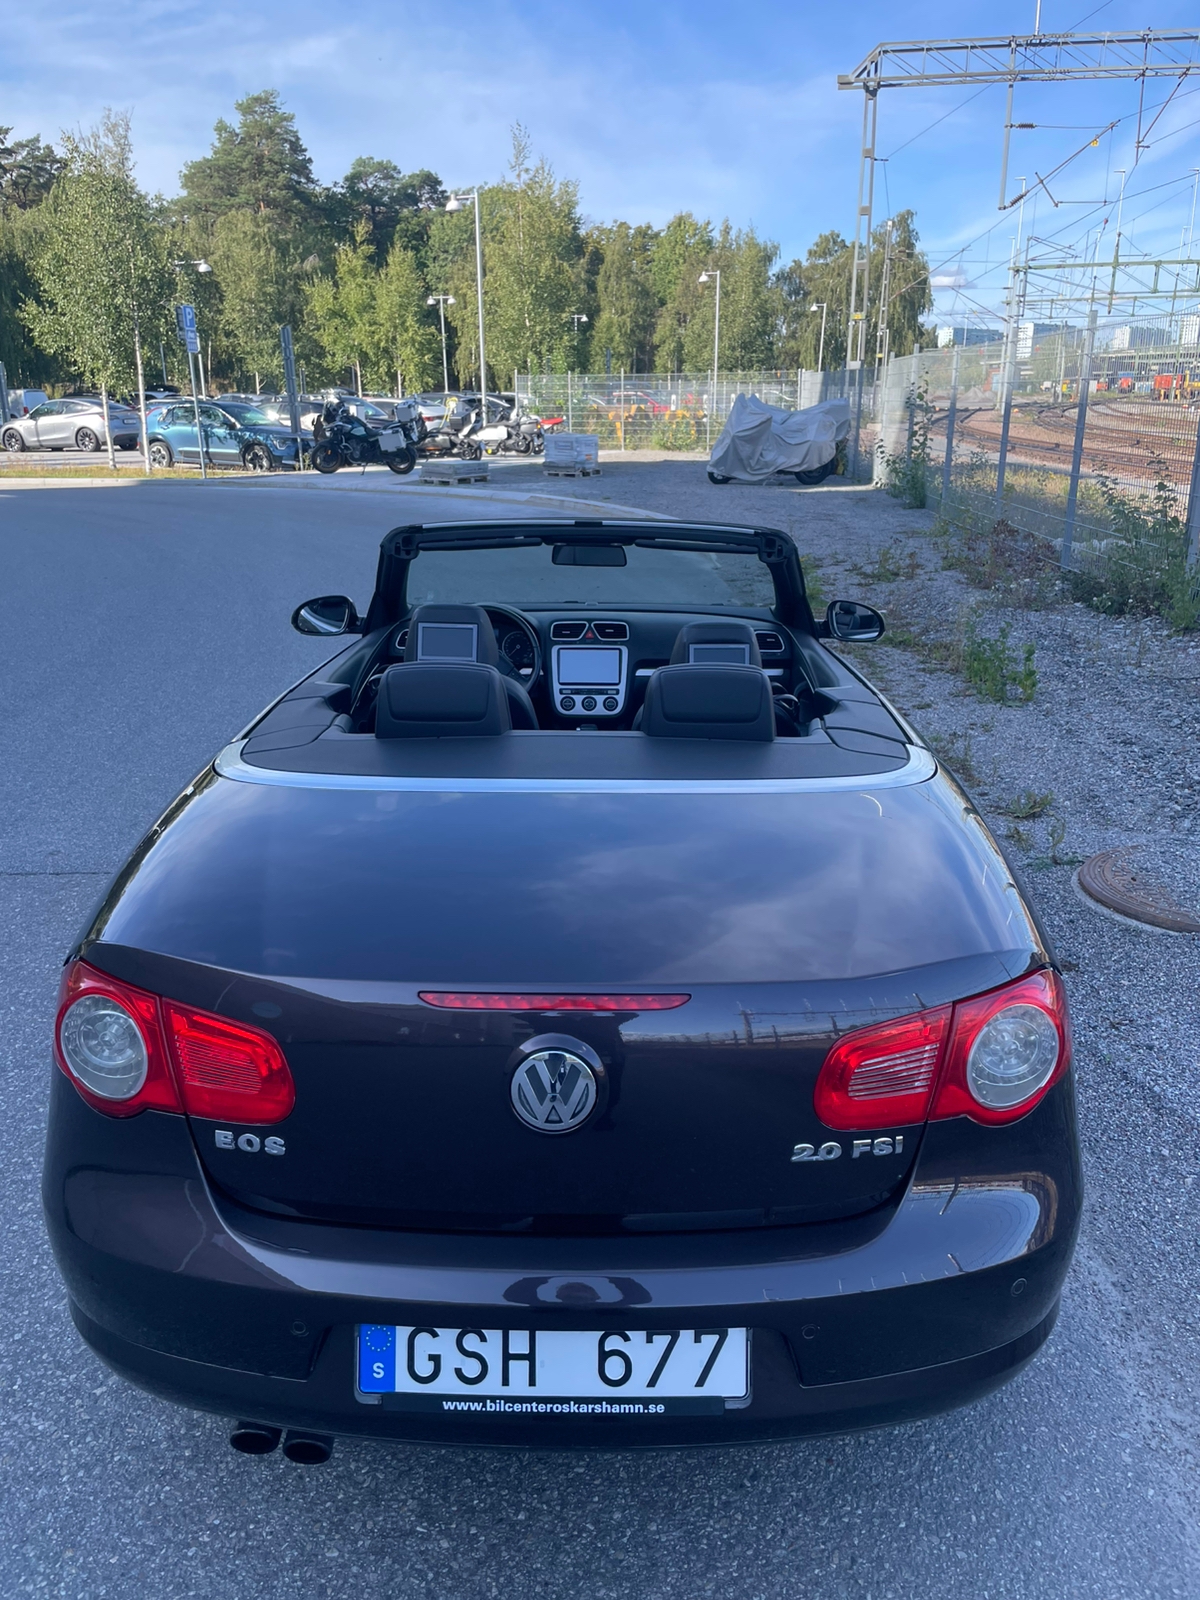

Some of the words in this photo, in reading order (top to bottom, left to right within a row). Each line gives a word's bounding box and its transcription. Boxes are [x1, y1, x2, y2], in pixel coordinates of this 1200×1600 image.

[185, 307, 193, 326] P
[511, 1051, 597, 1131] VW
[214, 1129, 286, 1156] EOS
[790, 1141, 842, 1162] 2.0
[852, 1135, 904, 1159] FSI
[372, 1362, 385, 1379] S
[406, 1326, 537, 1387] GSH
[597, 1330, 729, 1388] 677
[442, 1400, 666, 1414] www.bilcenteroskarshamn.se
